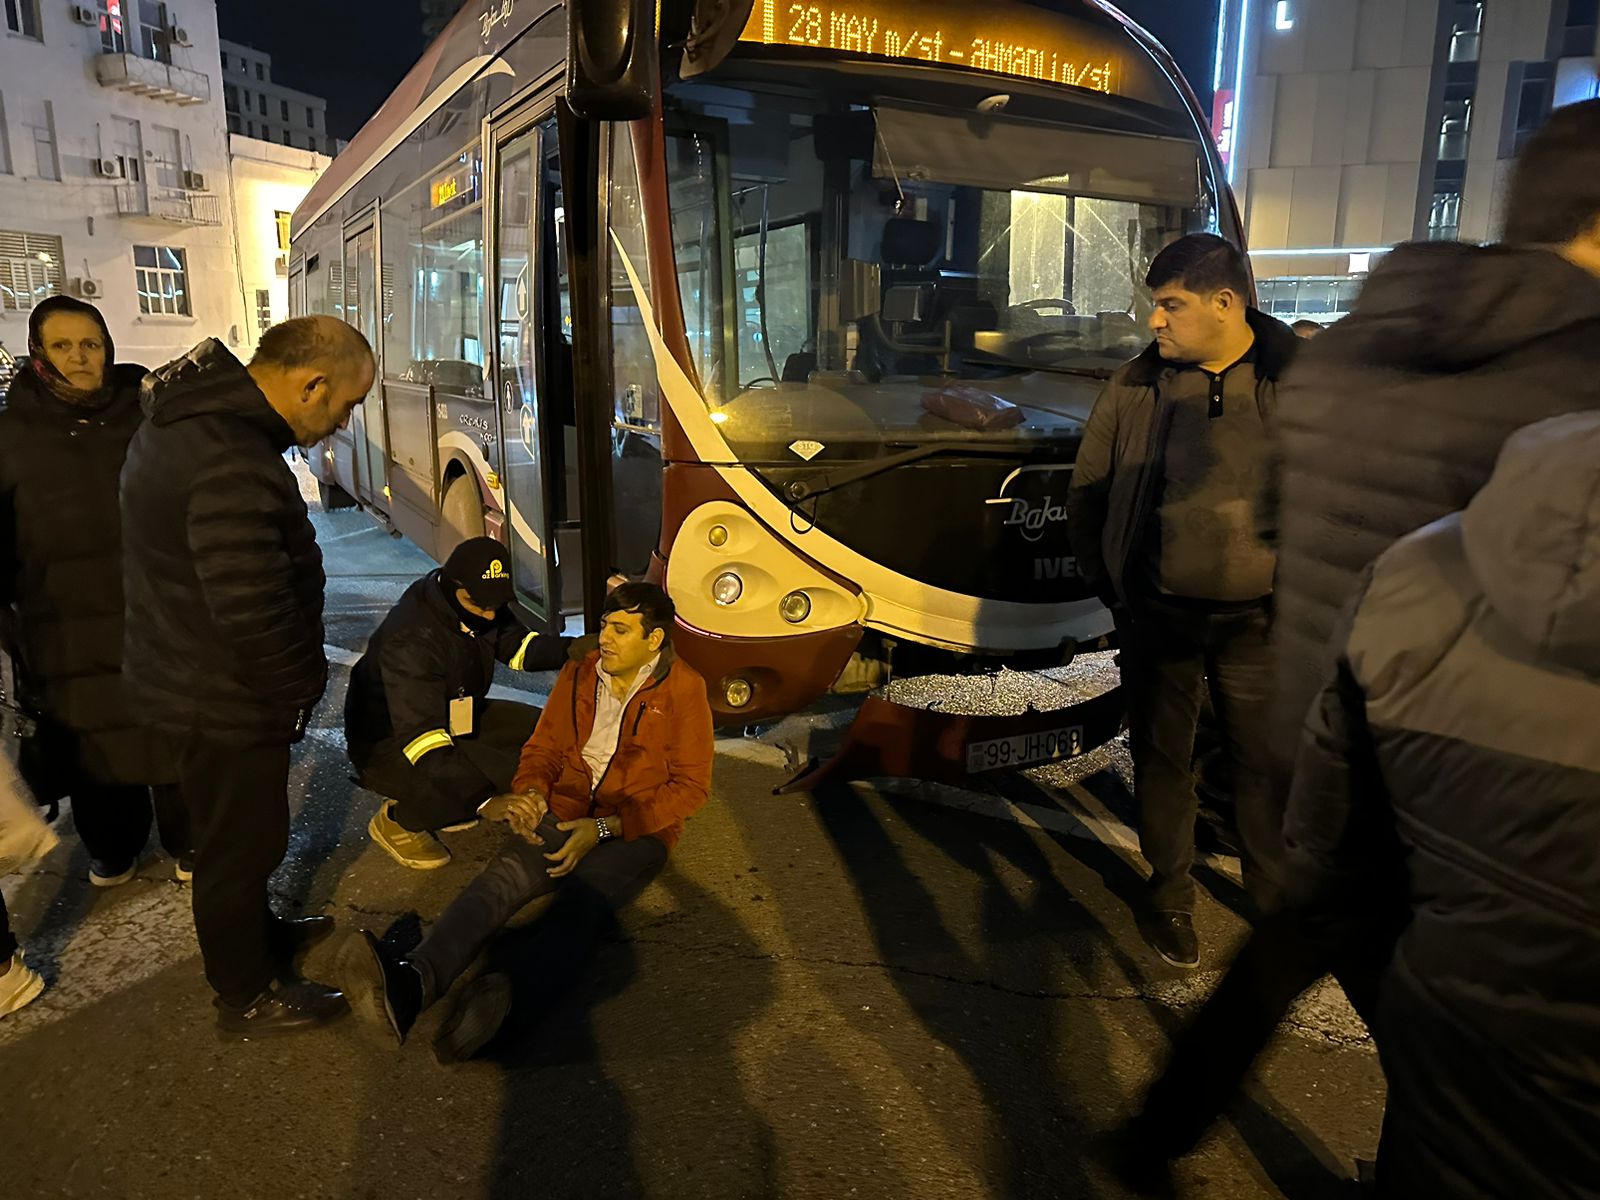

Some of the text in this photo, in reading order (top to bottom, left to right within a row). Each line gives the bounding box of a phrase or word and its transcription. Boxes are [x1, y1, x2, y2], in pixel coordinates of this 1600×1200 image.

[788, 3, 822, 44] 28
[829, 10, 879, 53] MAY
[885, 30, 943, 61] m/st
[1033, 556, 1084, 581] IVE
